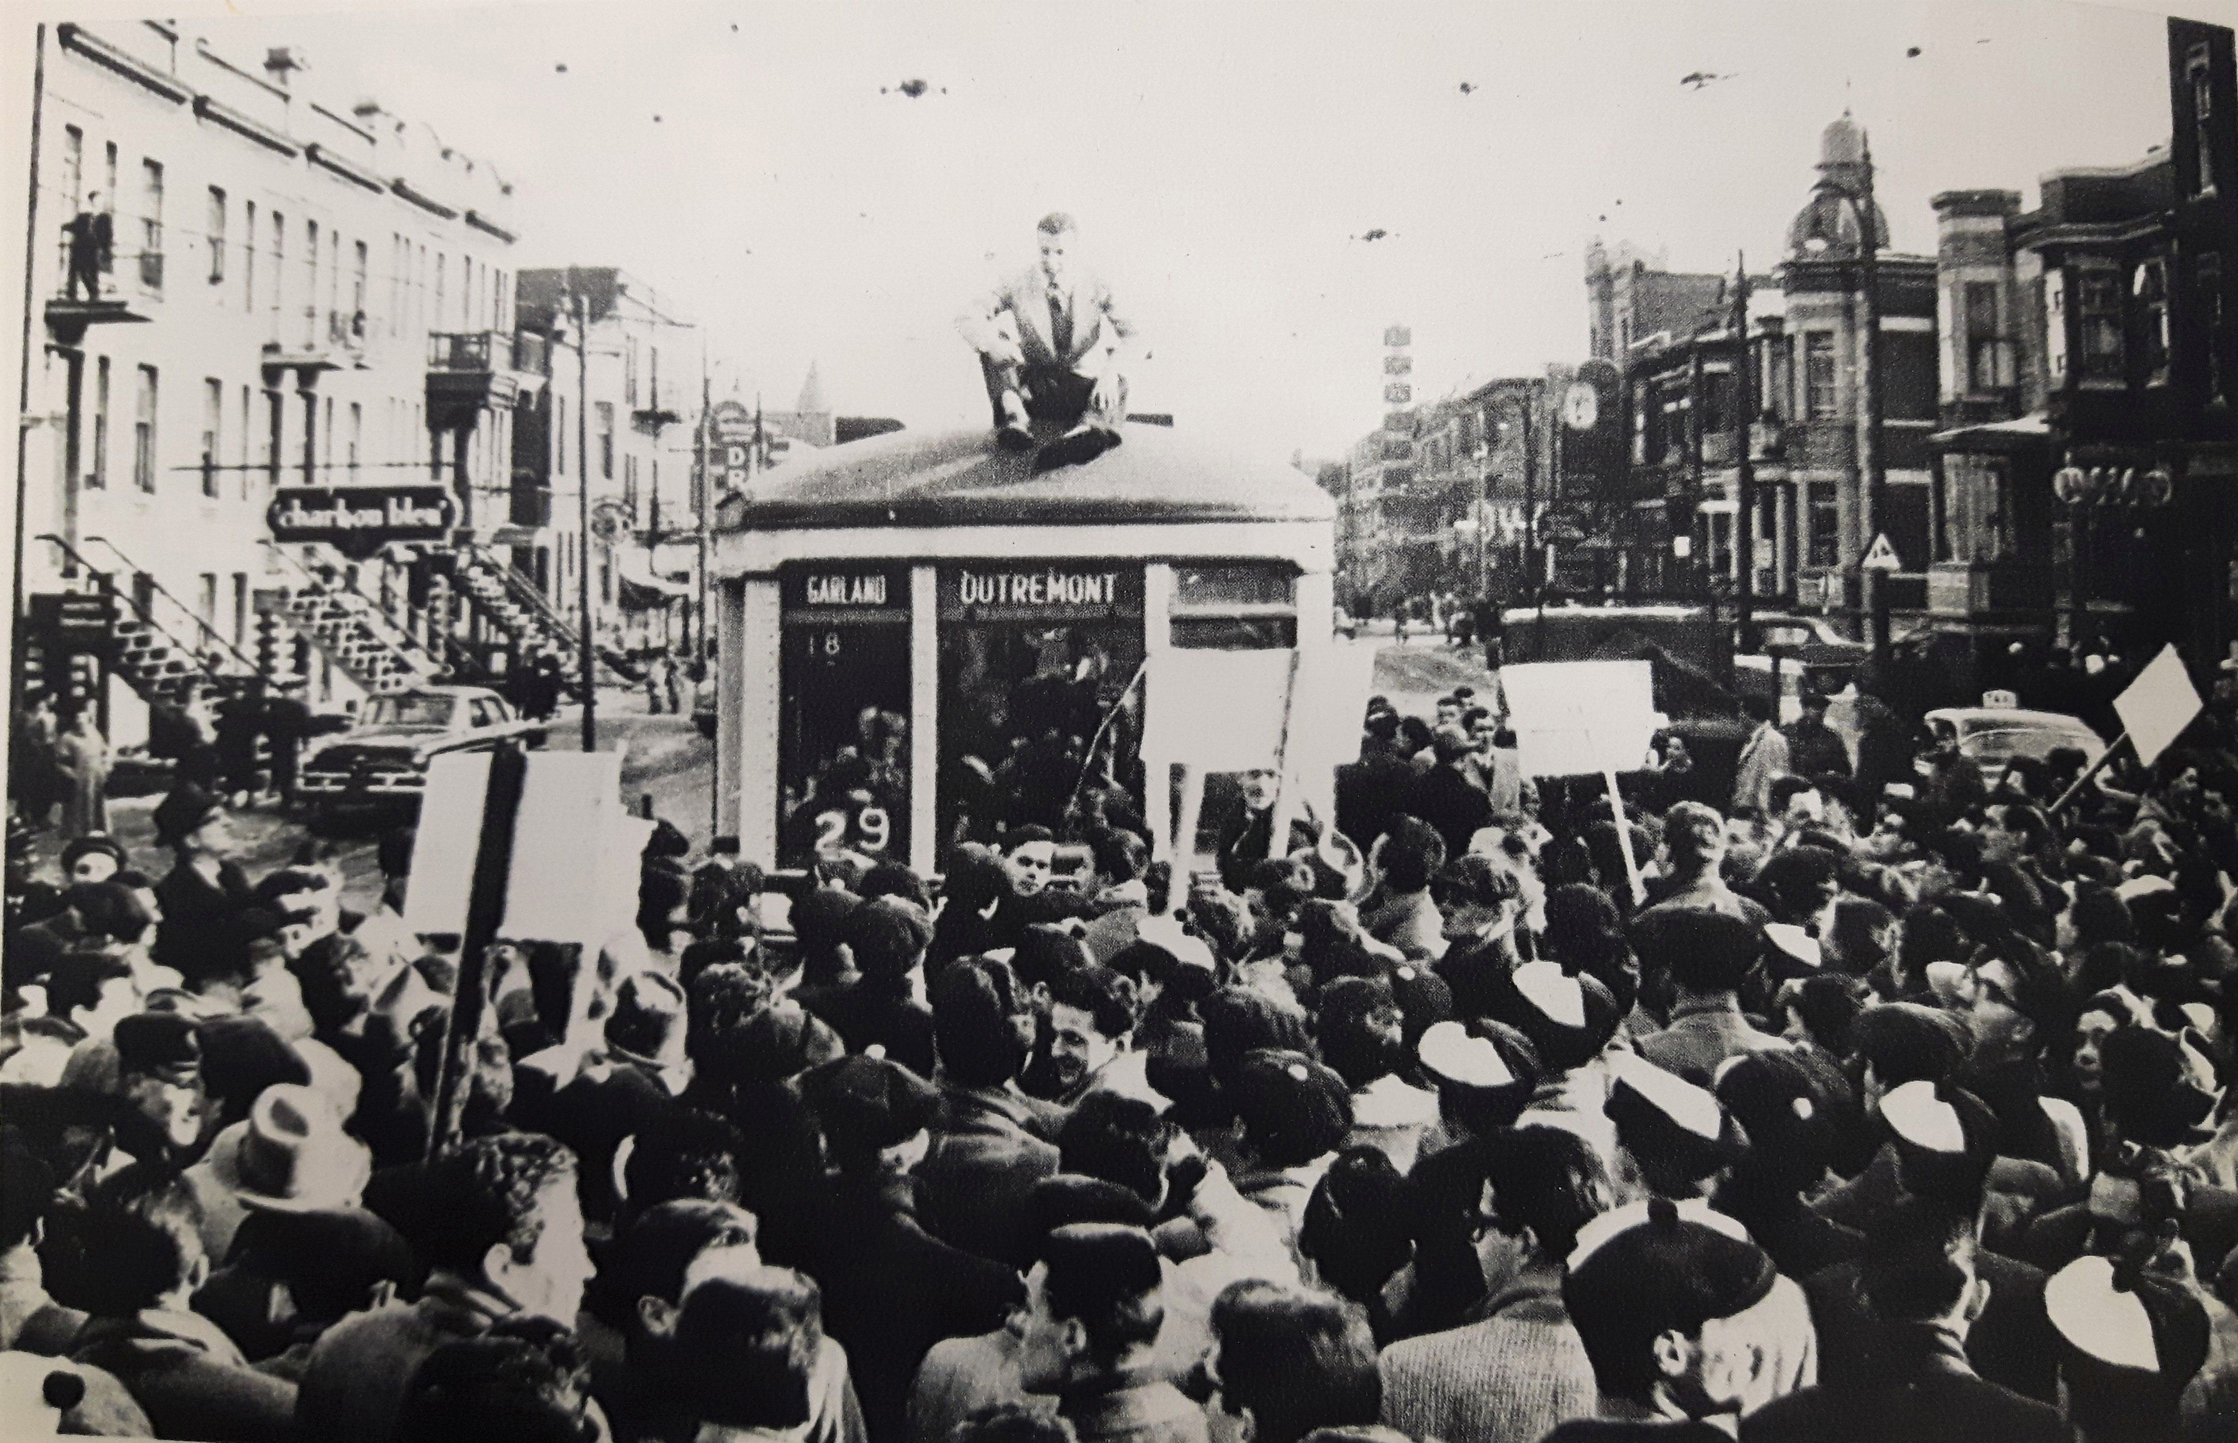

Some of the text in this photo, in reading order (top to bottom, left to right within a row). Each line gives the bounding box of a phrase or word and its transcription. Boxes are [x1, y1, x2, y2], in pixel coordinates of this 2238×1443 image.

[806, 575, 887, 605] GARLAND
[959, 571, 1117, 604] OUTREMONT
[809, 632, 840, 656] 18
[814, 806, 890, 862] 29
